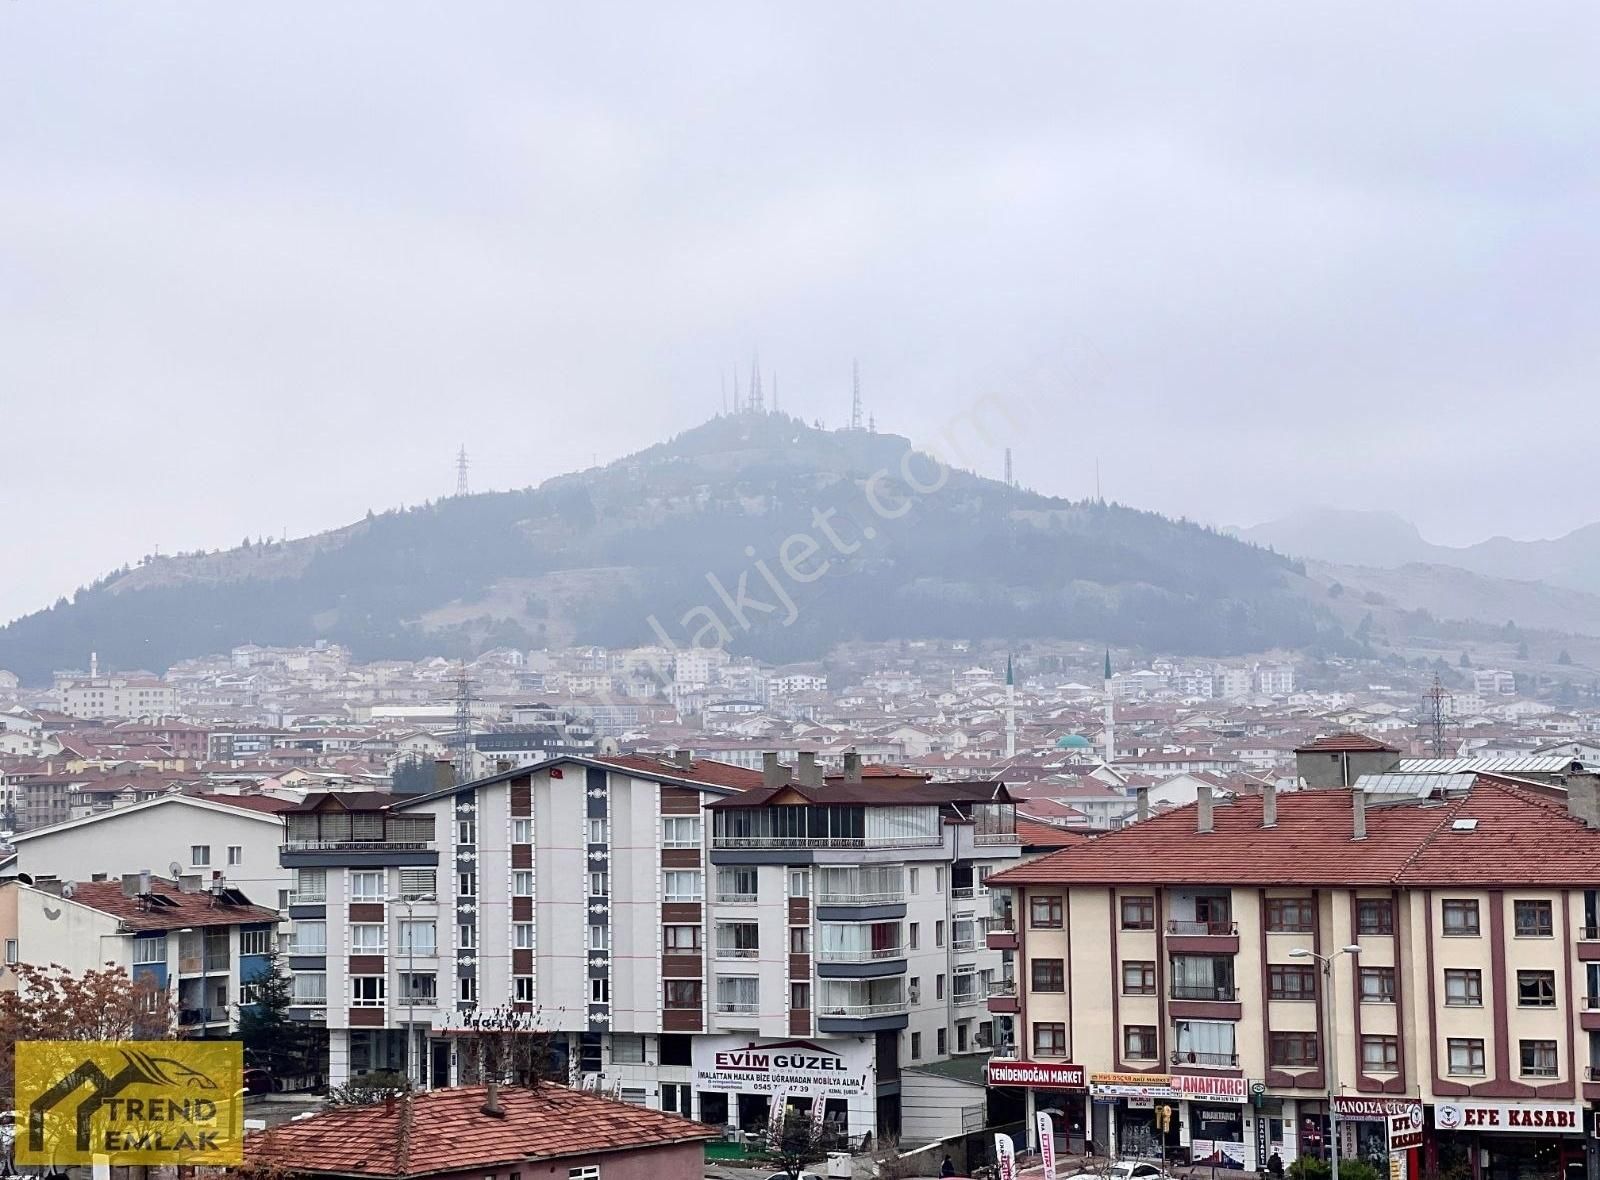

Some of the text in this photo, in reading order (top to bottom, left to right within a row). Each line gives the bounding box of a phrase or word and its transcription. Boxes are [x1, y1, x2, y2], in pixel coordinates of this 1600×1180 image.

[715, 1051, 848, 1071] EVİM GÜZEL
[697, 1071, 732, 1081] İMALATTAN
[733, 1072, 755, 1082] HALKA
[756, 1073, 771, 1082] BİZE
[771, 1073, 812, 1084] UĞRAMADAN
[813, 1076, 842, 1086] MOBİLYA
[842, 1078, 860, 1087] ALMA
[990, 1066, 1082, 1084] YENİDENDOĞAN MARKET
[1182, 1078, 1247, 1095] ANAHTARCI
[1391, 1117, 1411, 1132] EFE
[1464, 1108, 1499, 1126] EFE
[1508, 1109, 1576, 1128] KASABI
[1391, 1131, 1424, 1149] KASABI
